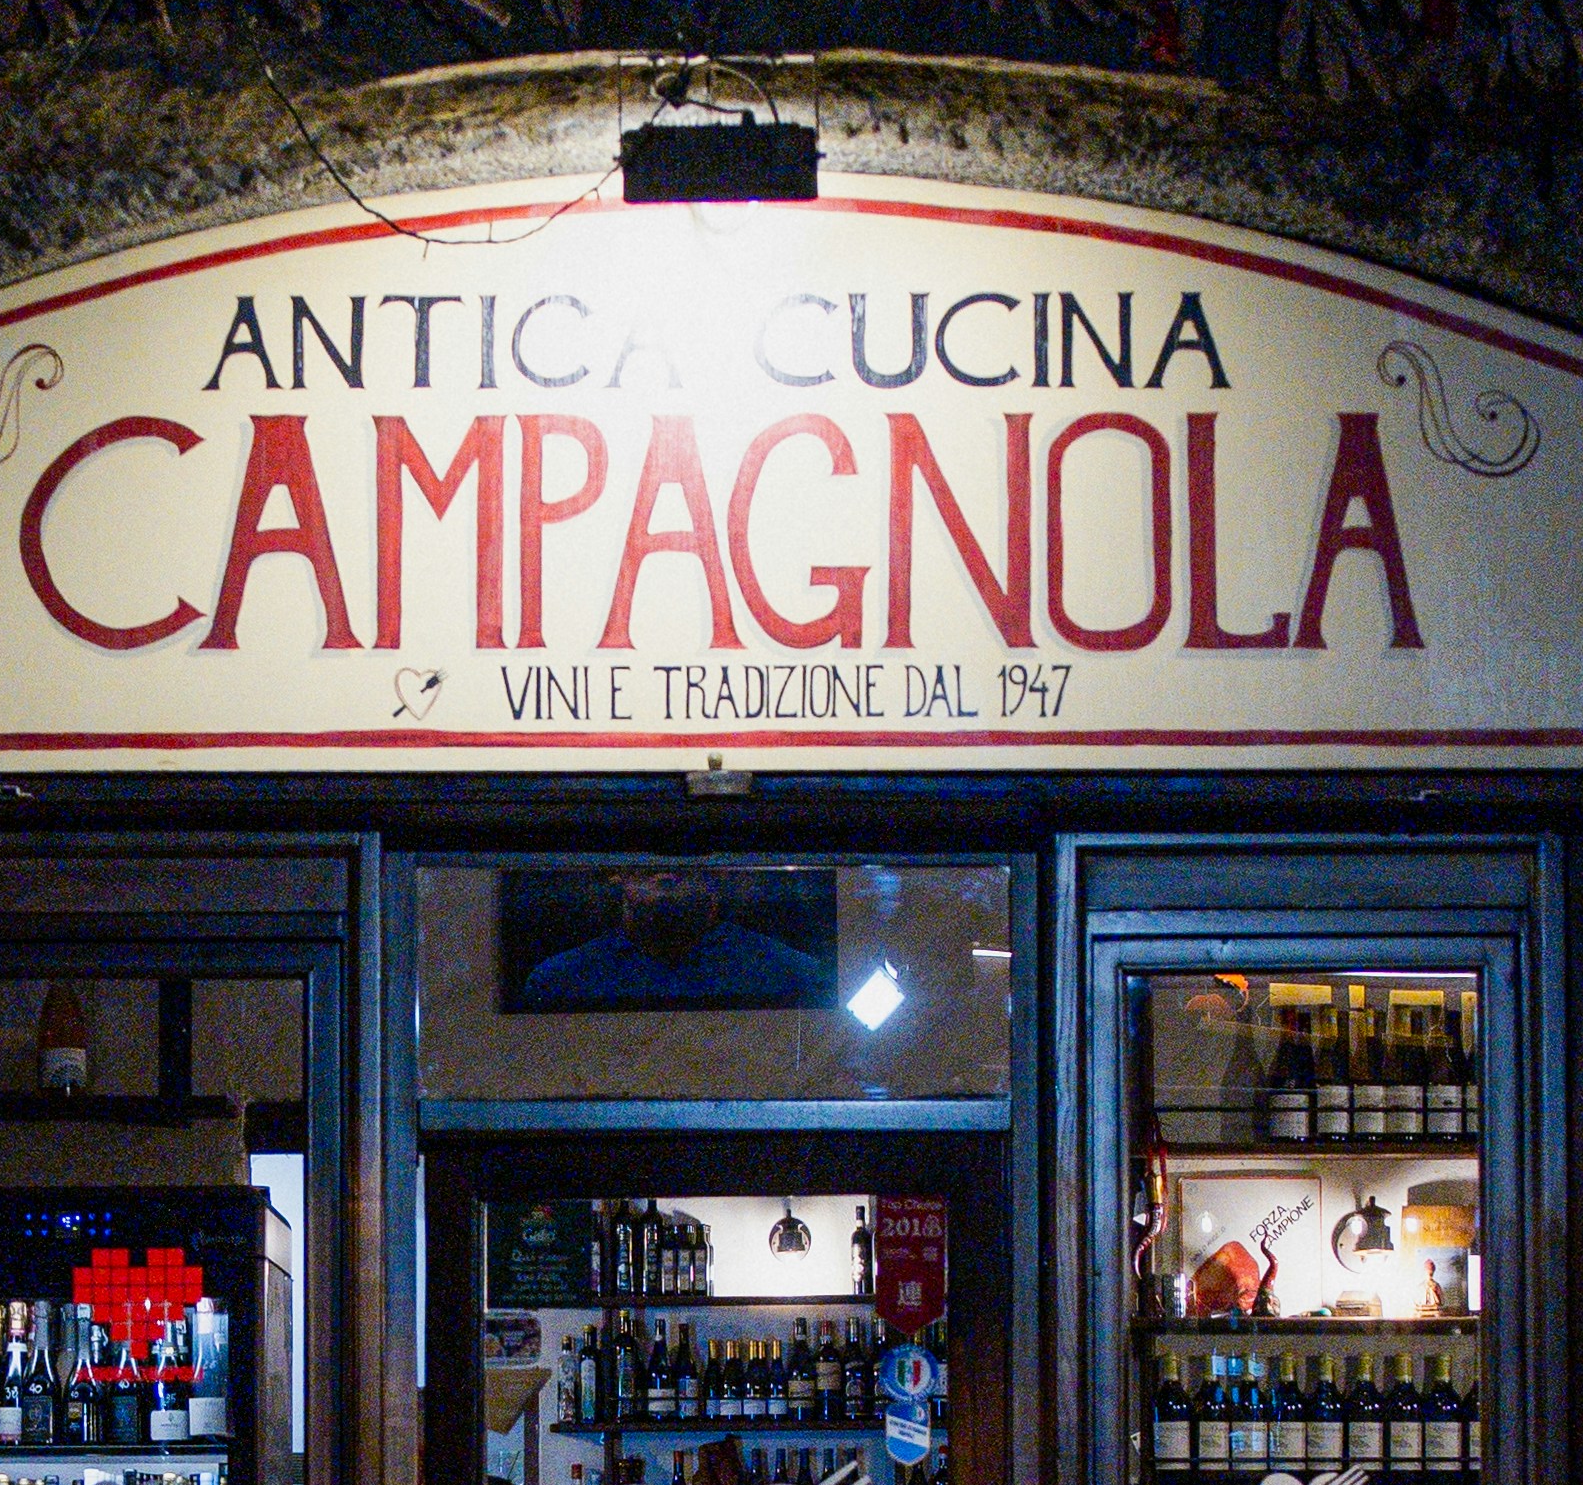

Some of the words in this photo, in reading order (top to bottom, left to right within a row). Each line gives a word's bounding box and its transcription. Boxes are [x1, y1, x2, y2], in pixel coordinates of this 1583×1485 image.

[201, 295, 684, 391] ANTICA
[753, 290, 1232, 390] CUCINA
[19, 412, 1428, 653] CAMPAGNOLA
[501, 664, 589, 720] VINI
[610, 665, 633, 720] E
[653, 664, 888, 720] TRADIZIONE
[901, 664, 979, 718] DAL
[995, 663, 1074, 718] 1947
[1266, 1194, 1316, 1249] AMPIONE
